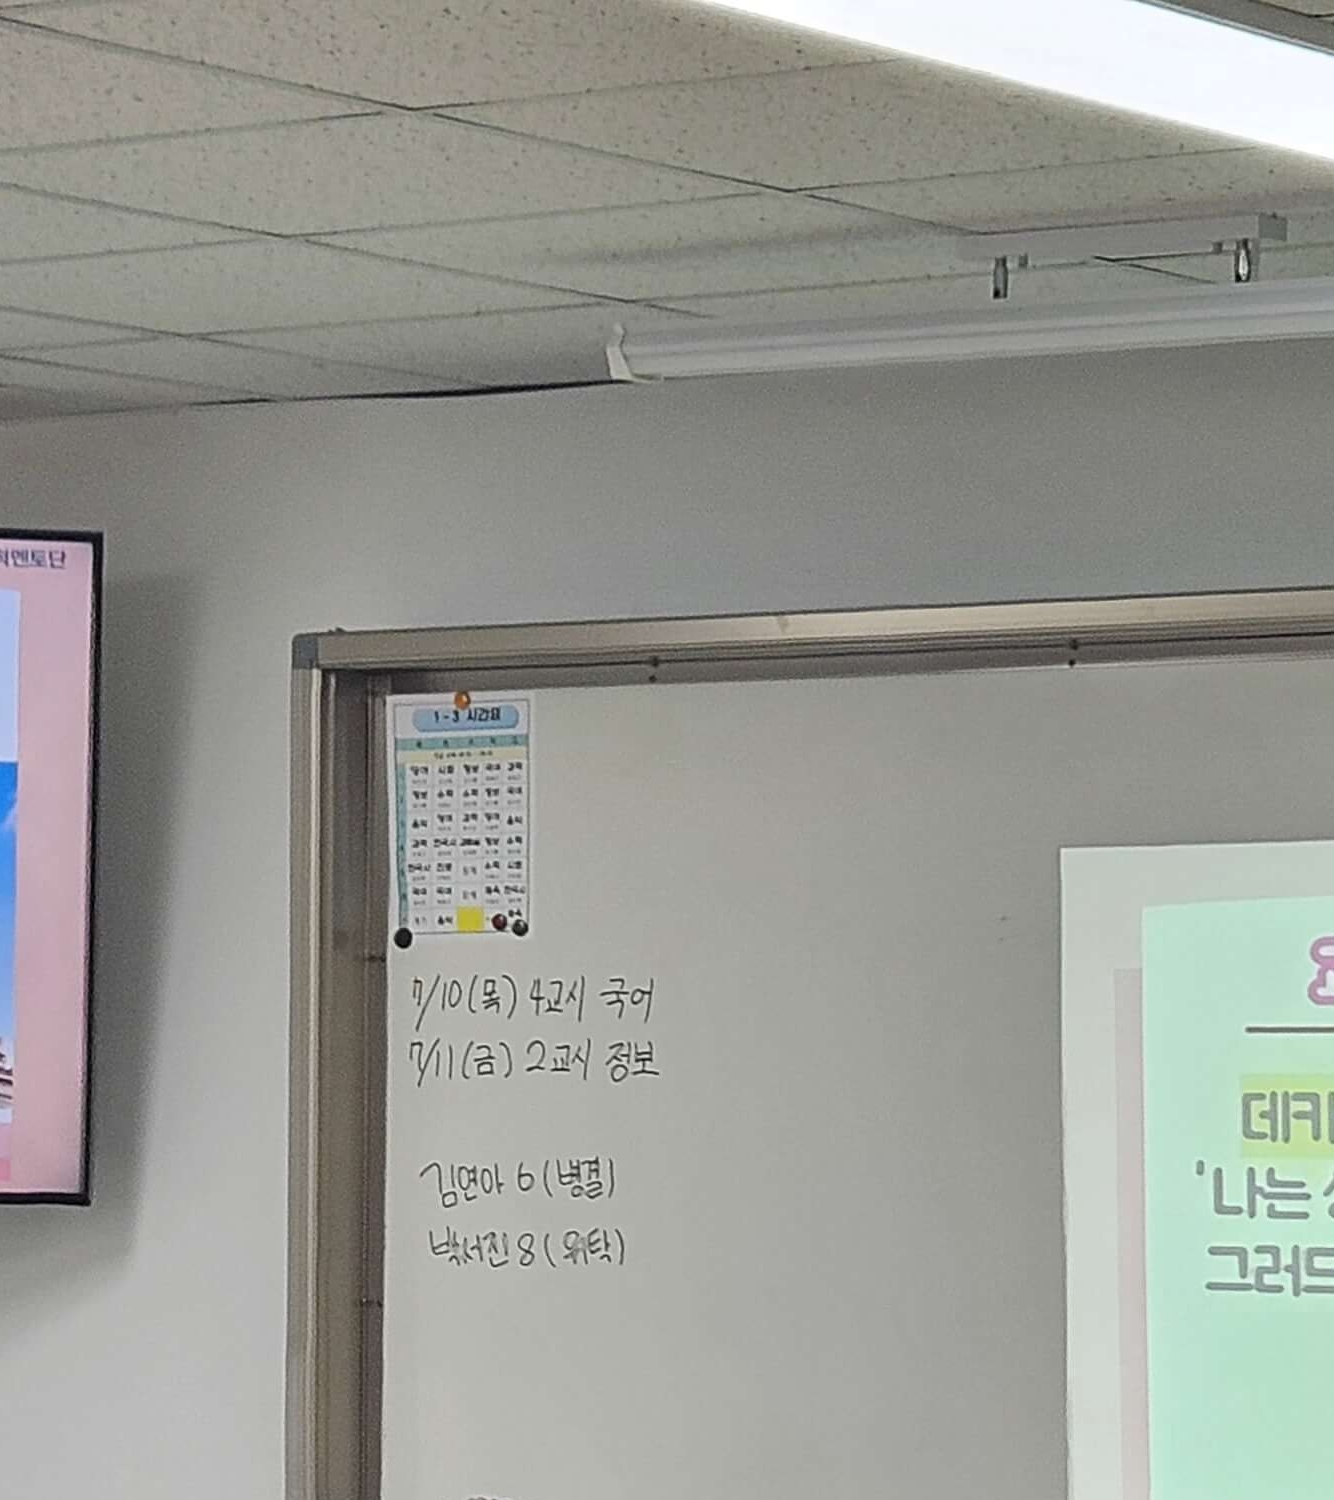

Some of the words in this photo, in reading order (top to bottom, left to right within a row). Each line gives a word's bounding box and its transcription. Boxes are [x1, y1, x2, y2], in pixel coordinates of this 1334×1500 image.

[413, 974, 518, 1033] 7/10(목)
[529, 975, 586, 1023] 4교시
[599, 978, 654, 1024] 국어
[409, 1037, 513, 1088] 7/11(금)
[526, 1037, 592, 1081] 2교시
[605, 1041, 660, 1083] 정보
